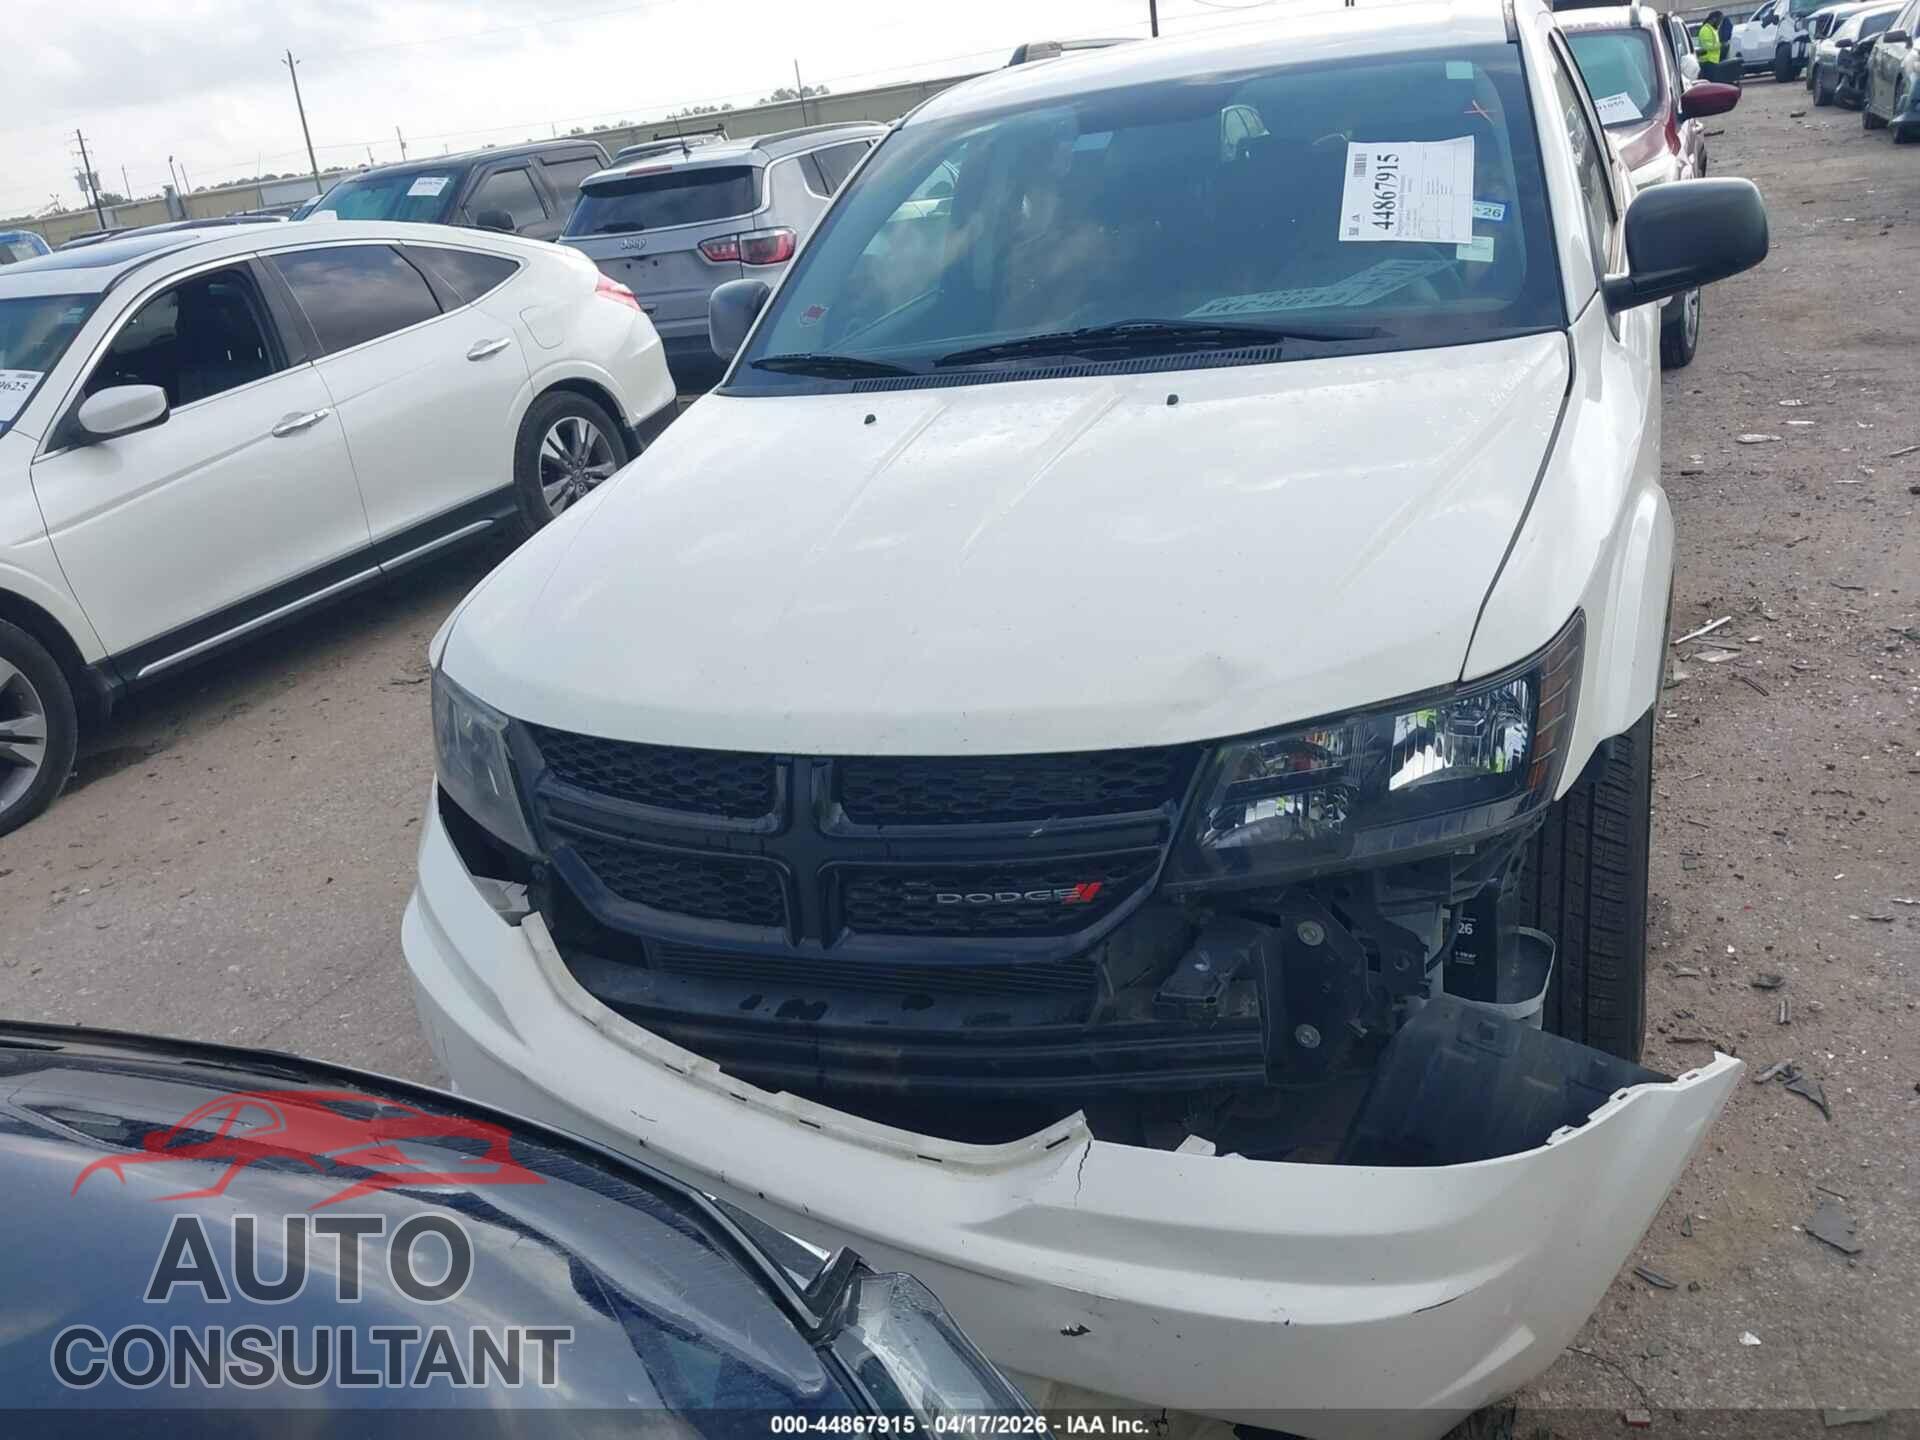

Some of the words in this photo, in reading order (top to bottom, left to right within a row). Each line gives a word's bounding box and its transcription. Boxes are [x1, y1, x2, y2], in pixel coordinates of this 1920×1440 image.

[1372, 153, 1400, 231] 44867915
[620, 239, 647, 250] Jeep
[936, 887, 1081, 904] DODGE
